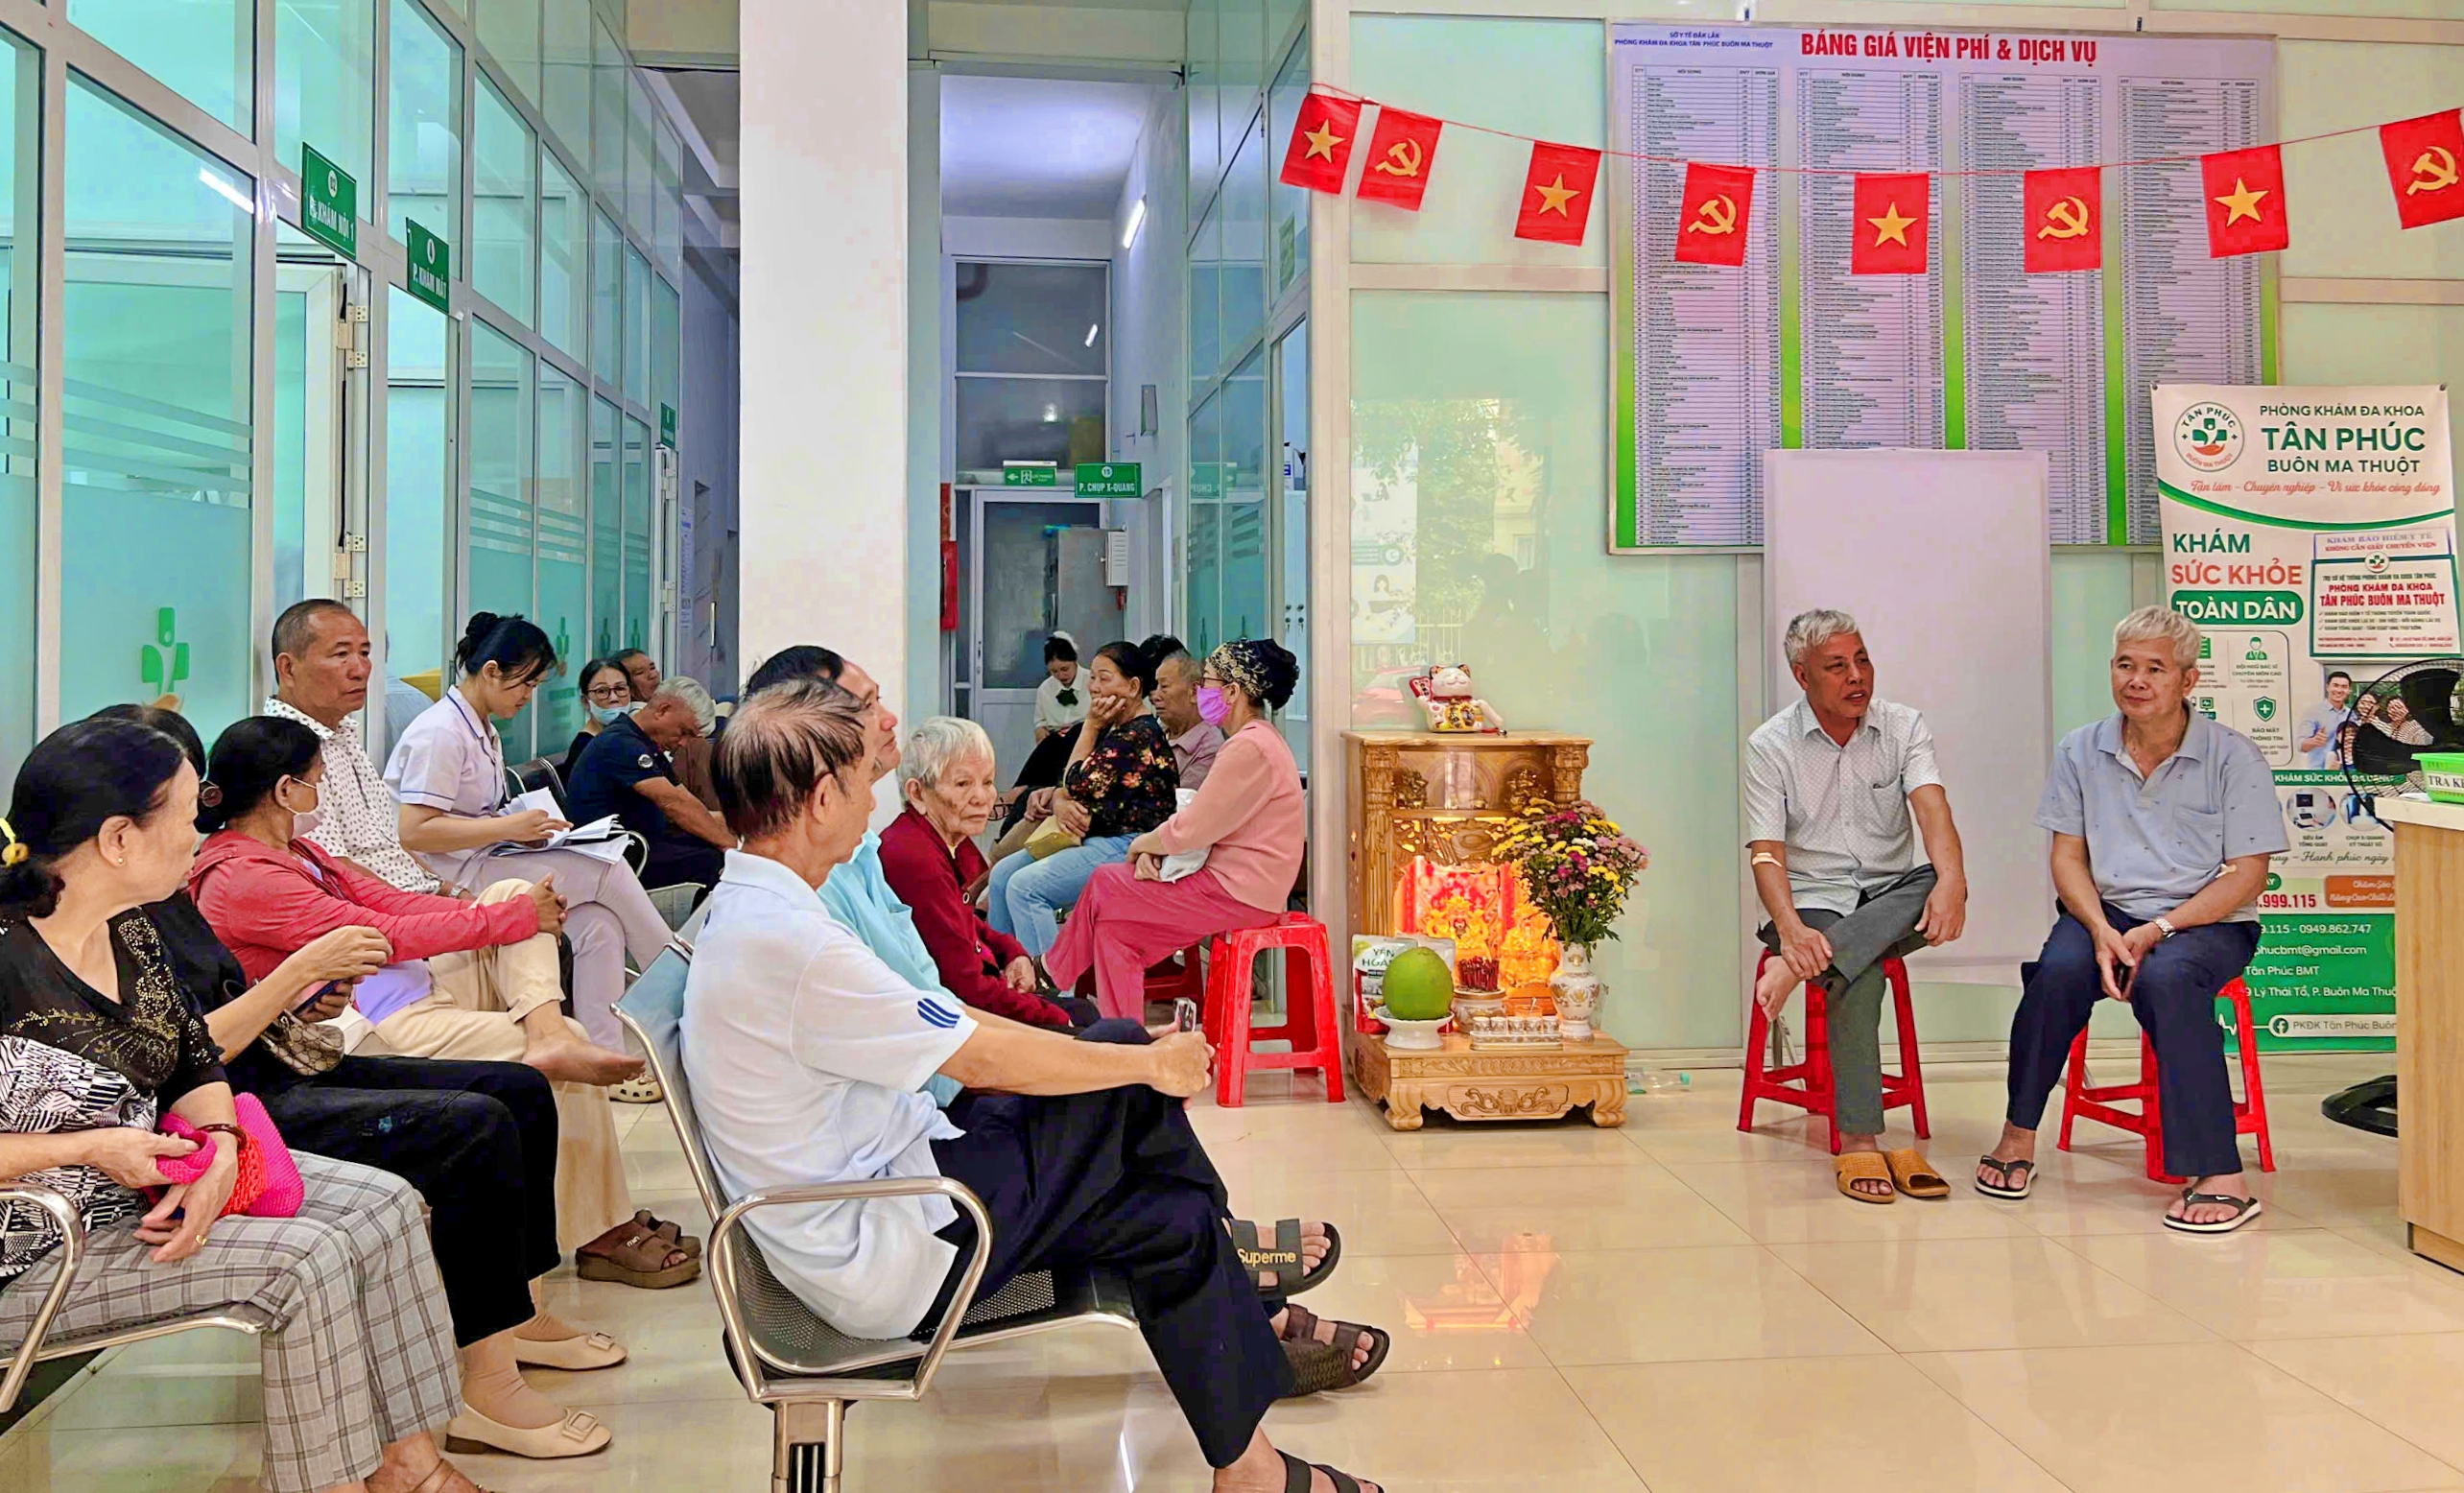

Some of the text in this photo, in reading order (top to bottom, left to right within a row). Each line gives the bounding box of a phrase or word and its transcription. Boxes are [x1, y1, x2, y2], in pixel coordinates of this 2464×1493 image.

[1801, 29, 2097, 67] BẢNG GIÁ VIỆN PHÍ & DỊCH VỤ
[2181, 407, 2236, 428] TÂN PHÚC
[2260, 404, 2425, 416] PHÒNG KHÁM ĐA KHOA
[2262, 421, 2426, 451] TÂN PHÚC
[2267, 456, 2421, 476] BUÔN MA THUỘT
[1087, 484, 1105, 493] CHỤP
[1105, 484, 1135, 492] X-QUANG
[2172, 529, 2251, 554] KHÁM
[2171, 557, 2303, 585] SỨC KHỎE
[2329, 582, 2359, 593] PHÒNG
[2362, 581, 2388, 592] KHÁM
[2406, 582, 2433, 591] KHOA
[2320, 592, 2445, 607] TÂN PHÚC BUÔN MA THUỘT
[2176, 596, 2296, 620] TOÀN DÂN
[2274, 772, 2303, 783] KHÁM
[2304, 772, 2323, 783] SỨC
[2301, 851, 2334, 865] Hạnh
[2335, 851, 2361, 865] phúc
[2363, 853, 2389, 865] ngày
[2256, 893, 2316, 908] .999.115
[2299, 924, 2372, 934] 0949.862.747
[2245, 965, 2319, 976] Tân Phúc BMT
[2255, 986, 2266, 998] Lý
[2268, 986, 2291, 997] Thái
[2312, 986, 2321, 997] P.
[2323, 986, 2350, 997] Buôn
[2352, 987, 2369, 997] Ma
[2293, 1021, 2321, 1030] PKĐK
[2324, 1021, 2342, 1030] Tân
[2344, 1020, 2369, 1030] Phúc
[1238, 1247, 1296, 1268] Superme
